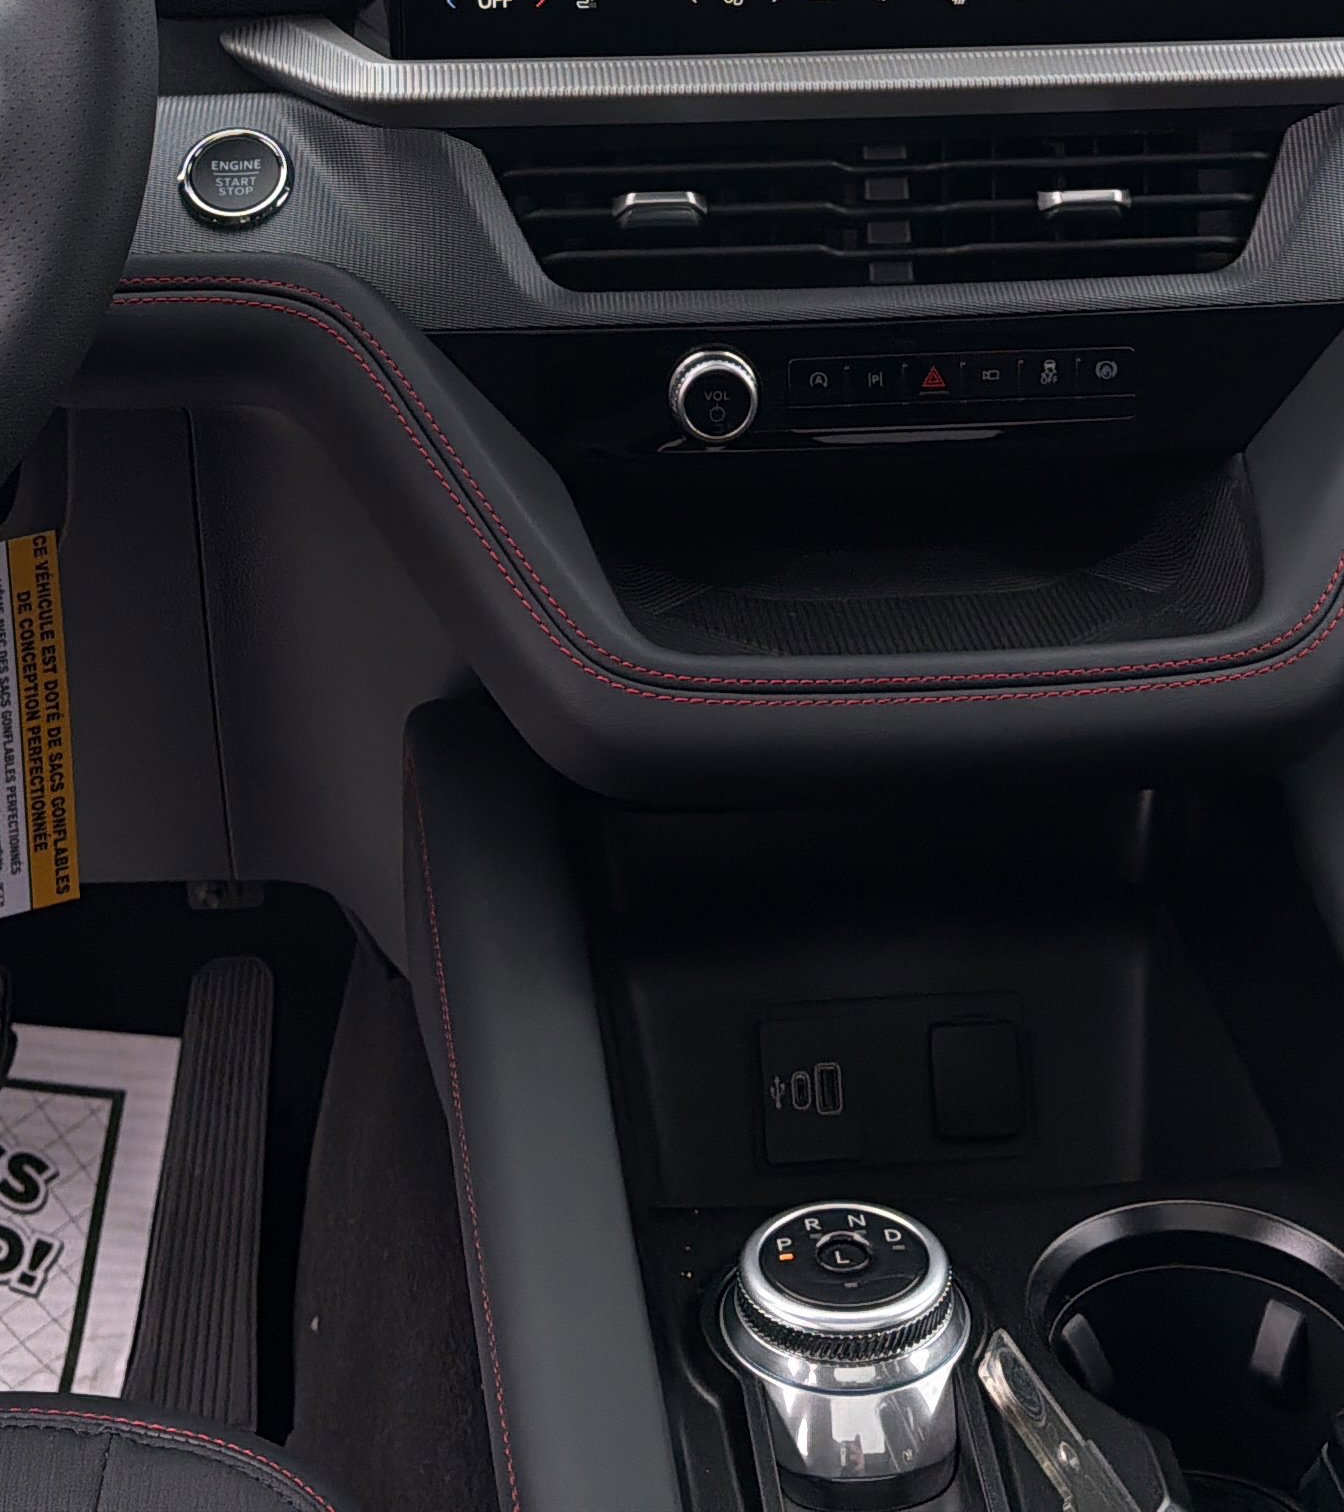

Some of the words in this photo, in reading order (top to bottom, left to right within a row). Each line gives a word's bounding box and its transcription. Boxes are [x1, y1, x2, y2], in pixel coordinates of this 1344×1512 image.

[211, 159, 262, 171] ENGINE
[216, 176, 257, 187] START
[218, 186, 254, 196] STOP
[704, 391, 730, 401] VOL
[34, 535, 47, 557] CE
[18, 591, 31, 613] DE
[36, 560, 56, 641] VÉHICULE
[0, 651, 8, 673] DES
[20, 618, 39, 721] CONCEPTION
[43, 645, 56, 675] EST
[0, 677, 10, 707] SACS
[46, 679, 62, 722] DOTÉ
[2, 711, 15, 783] GONFLABLES
[49, 727, 61, 748] DE
[49, 752, 64, 792] SACS
[26, 725, 50, 852] PERFECTIONNÉE
[6, 786, 23, 875] PERFECTIONNÉS
[51, 796, 71, 895] GONFLABLES
[777, 1238, 792, 1252] P
[805, 1218, 822, 1230] R
[848, 1214, 866, 1227] N
[884, 1229, 902, 1242] D
[835, 1251, 850, 1264] L
